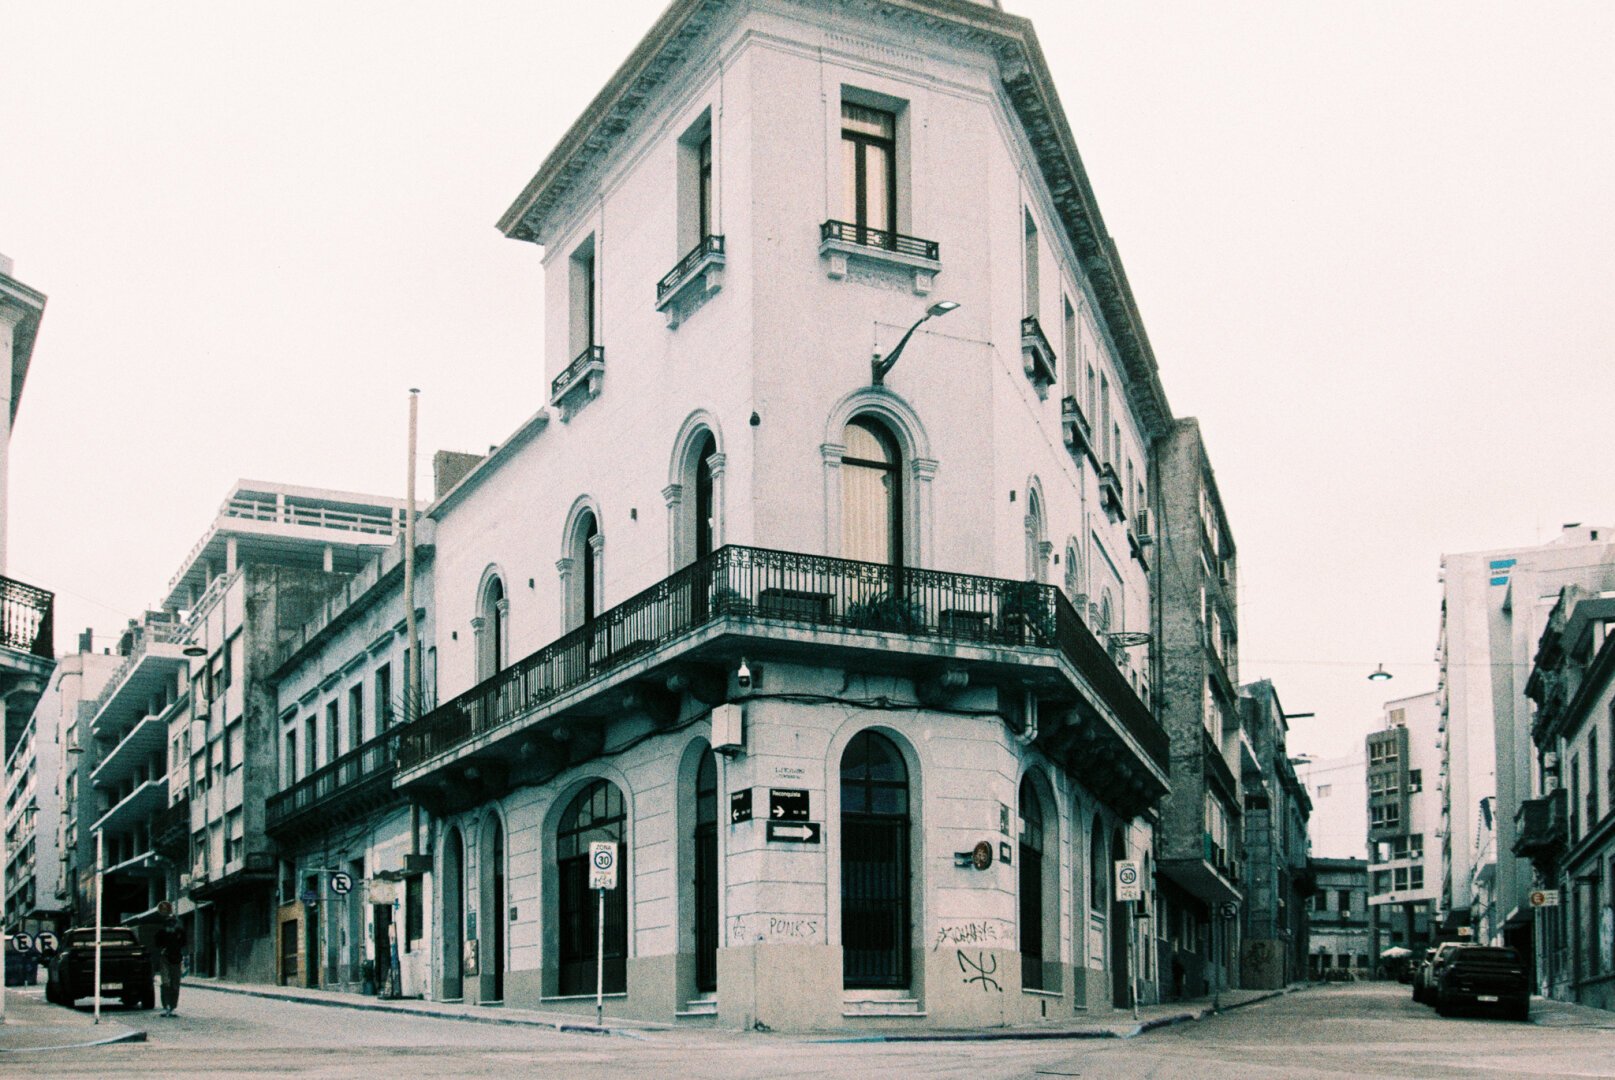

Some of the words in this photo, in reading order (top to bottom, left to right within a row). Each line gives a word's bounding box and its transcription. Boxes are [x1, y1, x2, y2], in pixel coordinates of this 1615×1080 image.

[772, 790, 801, 798] Reconquista
[595, 843, 612, 851] ZONA
[598, 855, 610, 866] 30
[1123, 872, 1134, 881] 30
